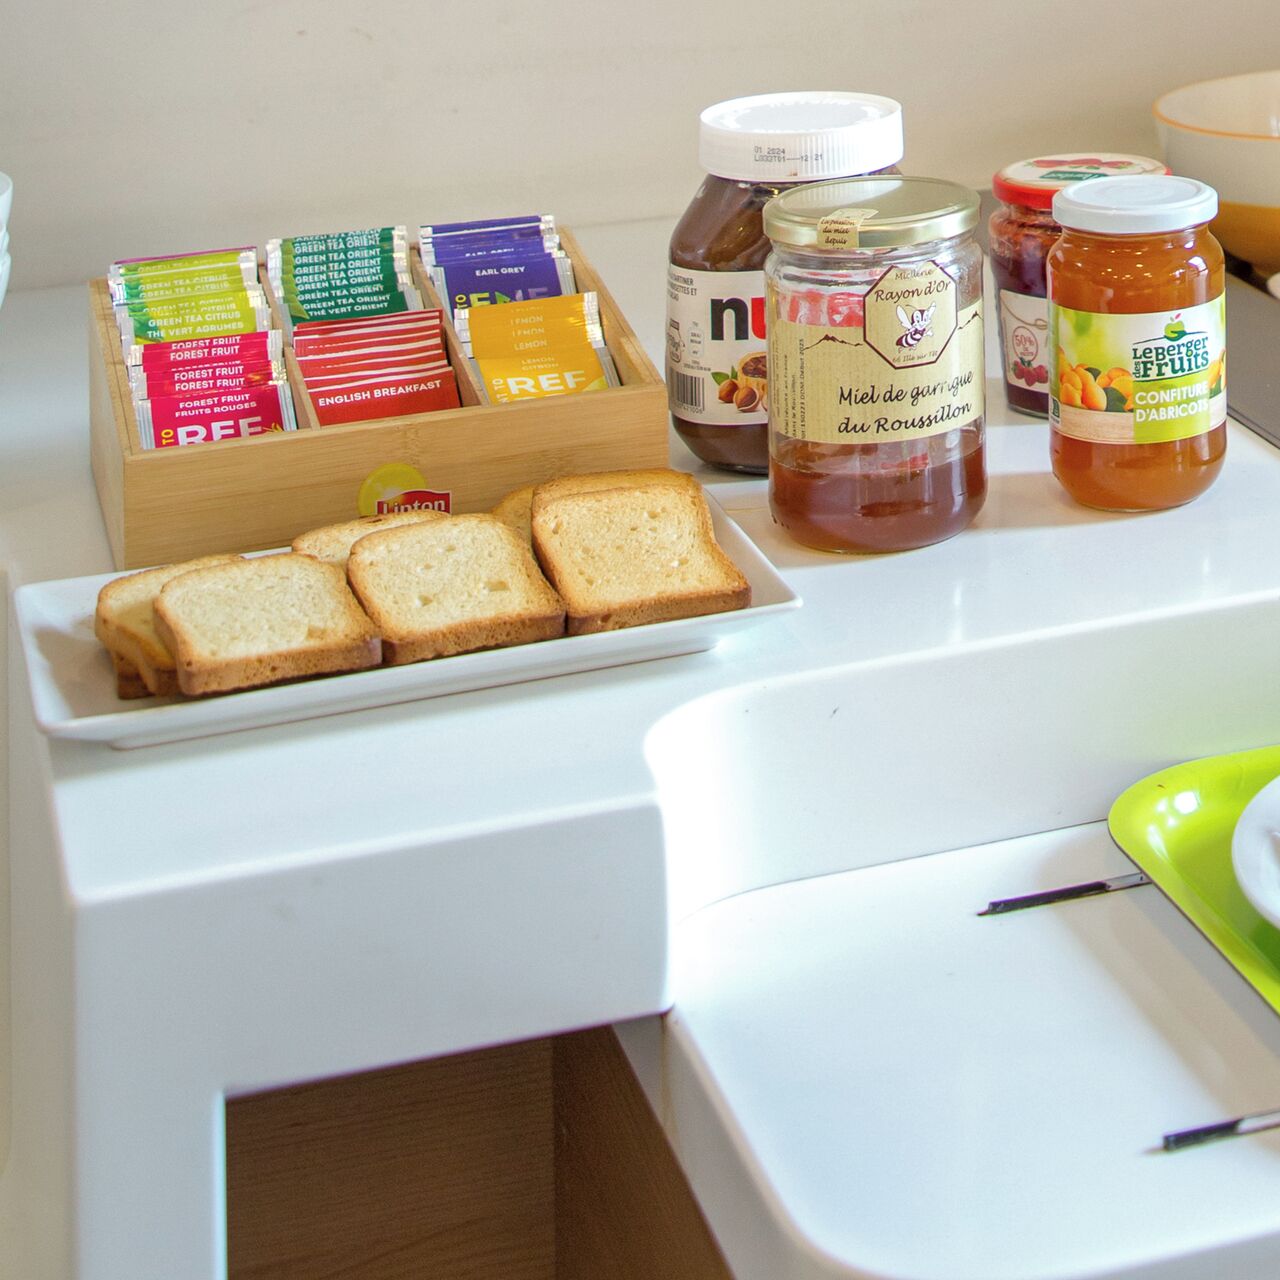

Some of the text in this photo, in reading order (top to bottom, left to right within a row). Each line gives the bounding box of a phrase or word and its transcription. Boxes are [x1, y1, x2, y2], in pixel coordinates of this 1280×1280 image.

[294, 243, 326, 255] GREEN
[327, 241, 345, 251] TEA
[346, 238, 381, 249] ORIENT
[294, 248, 381, 265] GREEN TEA ORIENT
[328, 261, 345, 271] TEA
[347, 257, 381, 268] ORIENT
[295, 266, 382, 284] GREEN TEA ORIENT
[475, 266, 526, 277] EARL GREY
[297, 273, 384, 291] GREEN TEA ORIENT
[297, 284, 385, 301] GREEN TEA ORIENT
[875, 280, 951, 304] Rayon d'Or
[303, 294, 391, 310] GREEN TEA ORIENT
[328, 305, 352, 314] VERT
[353, 302, 389, 312] ORIENT
[148, 317, 182, 328] GREEN
[184, 313, 203, 324] TEA
[205, 310, 241, 322] CITRUS
[168, 326, 194, 337] VERT
[194, 322, 244, 334] AGRUMES
[514, 338, 548, 351] LEMON
[170, 345, 240, 362] FOREST FRUIT
[174, 370, 213, 381] FOREST
[215, 365, 244, 376] FRUIT
[1132, 350, 1210, 379] des Fruits
[175, 377, 245, 391] FOREST FRUIT
[1135, 380, 1209, 405] CONFITURE
[179, 393, 251, 409] FOREST FRUIT
[318, 379, 443, 407] ENGLISH BREAKFAST
[838, 384, 880, 406] Miel
[882, 383, 907, 403] de
[175, 401, 257, 418] FRUITS ROUGES
[837, 401, 973, 434] du Roussillon
[1135, 398, 1210, 423] D'ABRICOTS
